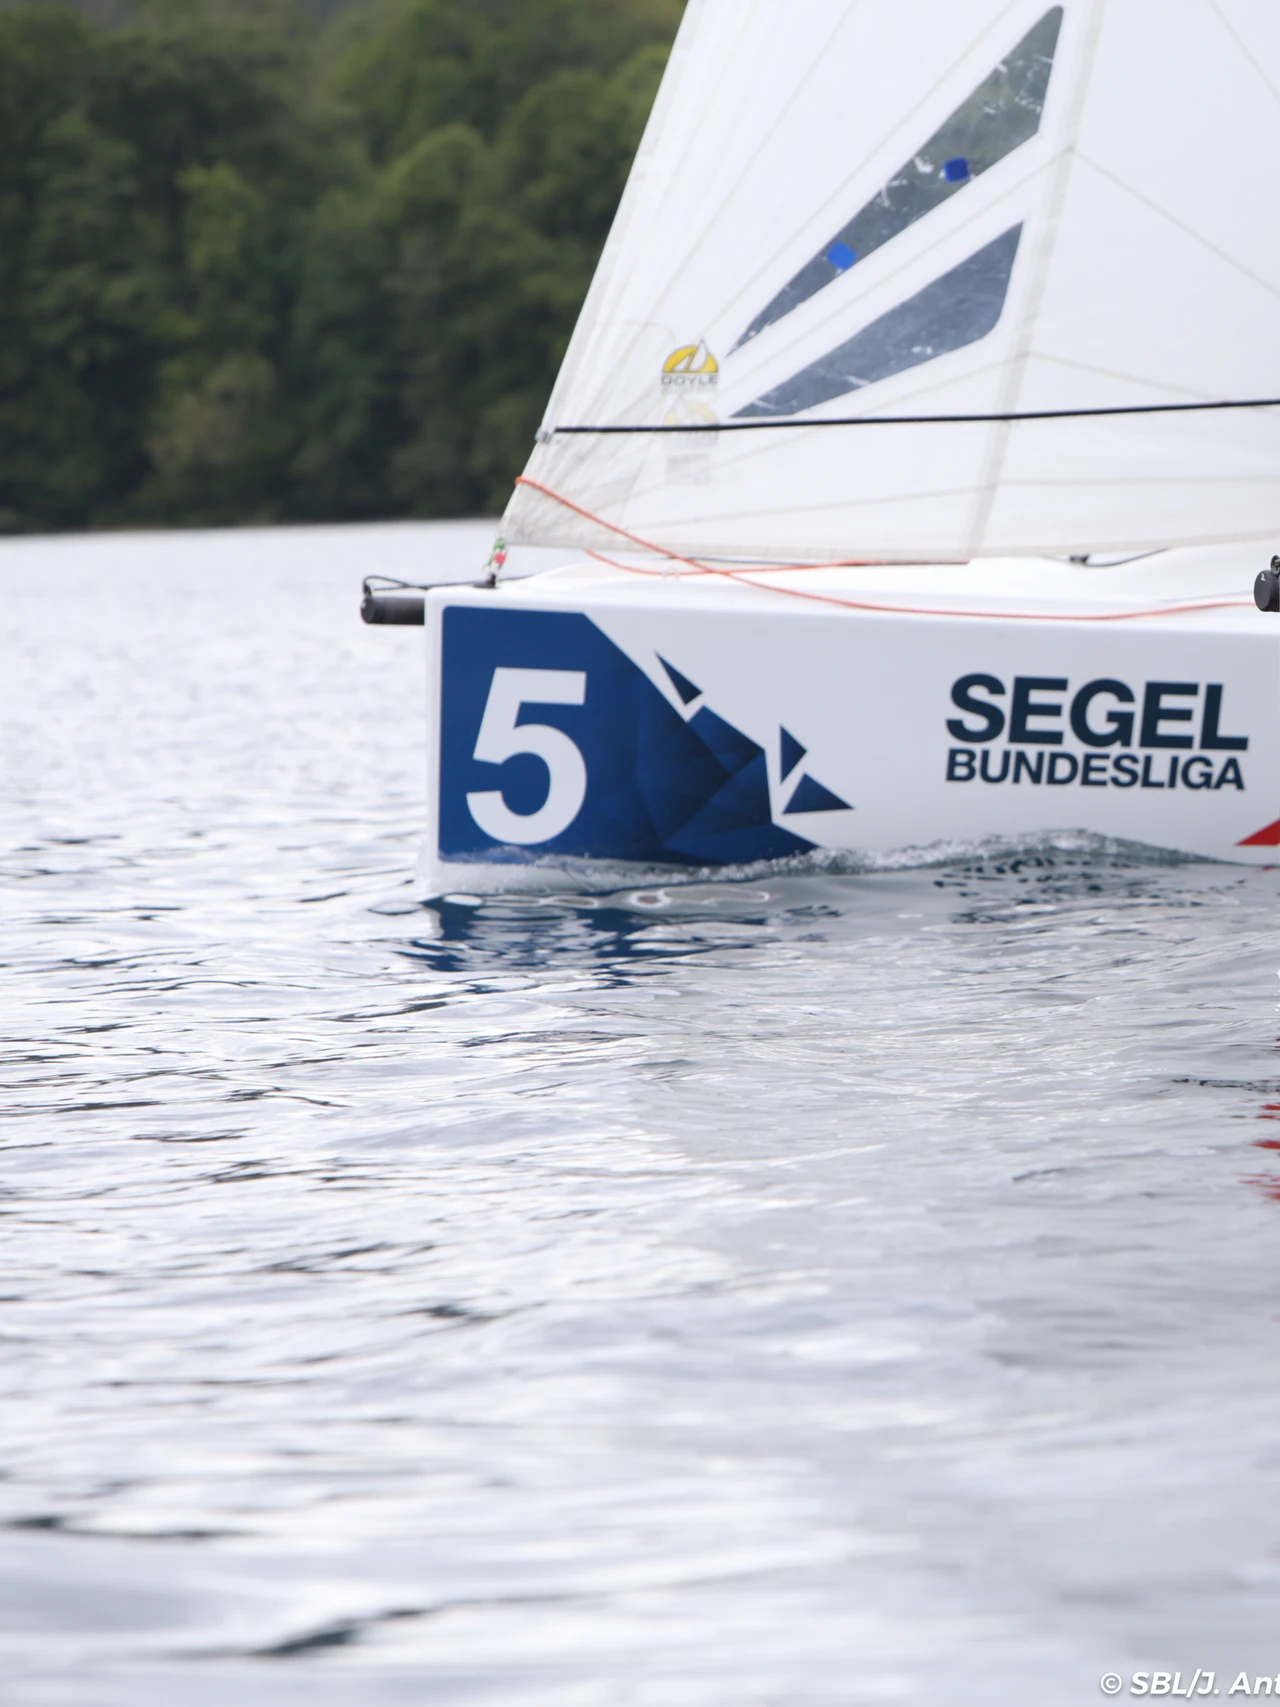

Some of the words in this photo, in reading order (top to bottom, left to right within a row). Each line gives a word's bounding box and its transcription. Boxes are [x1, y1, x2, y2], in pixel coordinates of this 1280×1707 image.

[662, 375, 718, 385] DOYLE
[946, 673, 1249, 751] SEGEL
[466, 667, 587, 845] 5
[946, 748, 1245, 791] BUNDESLIGA
